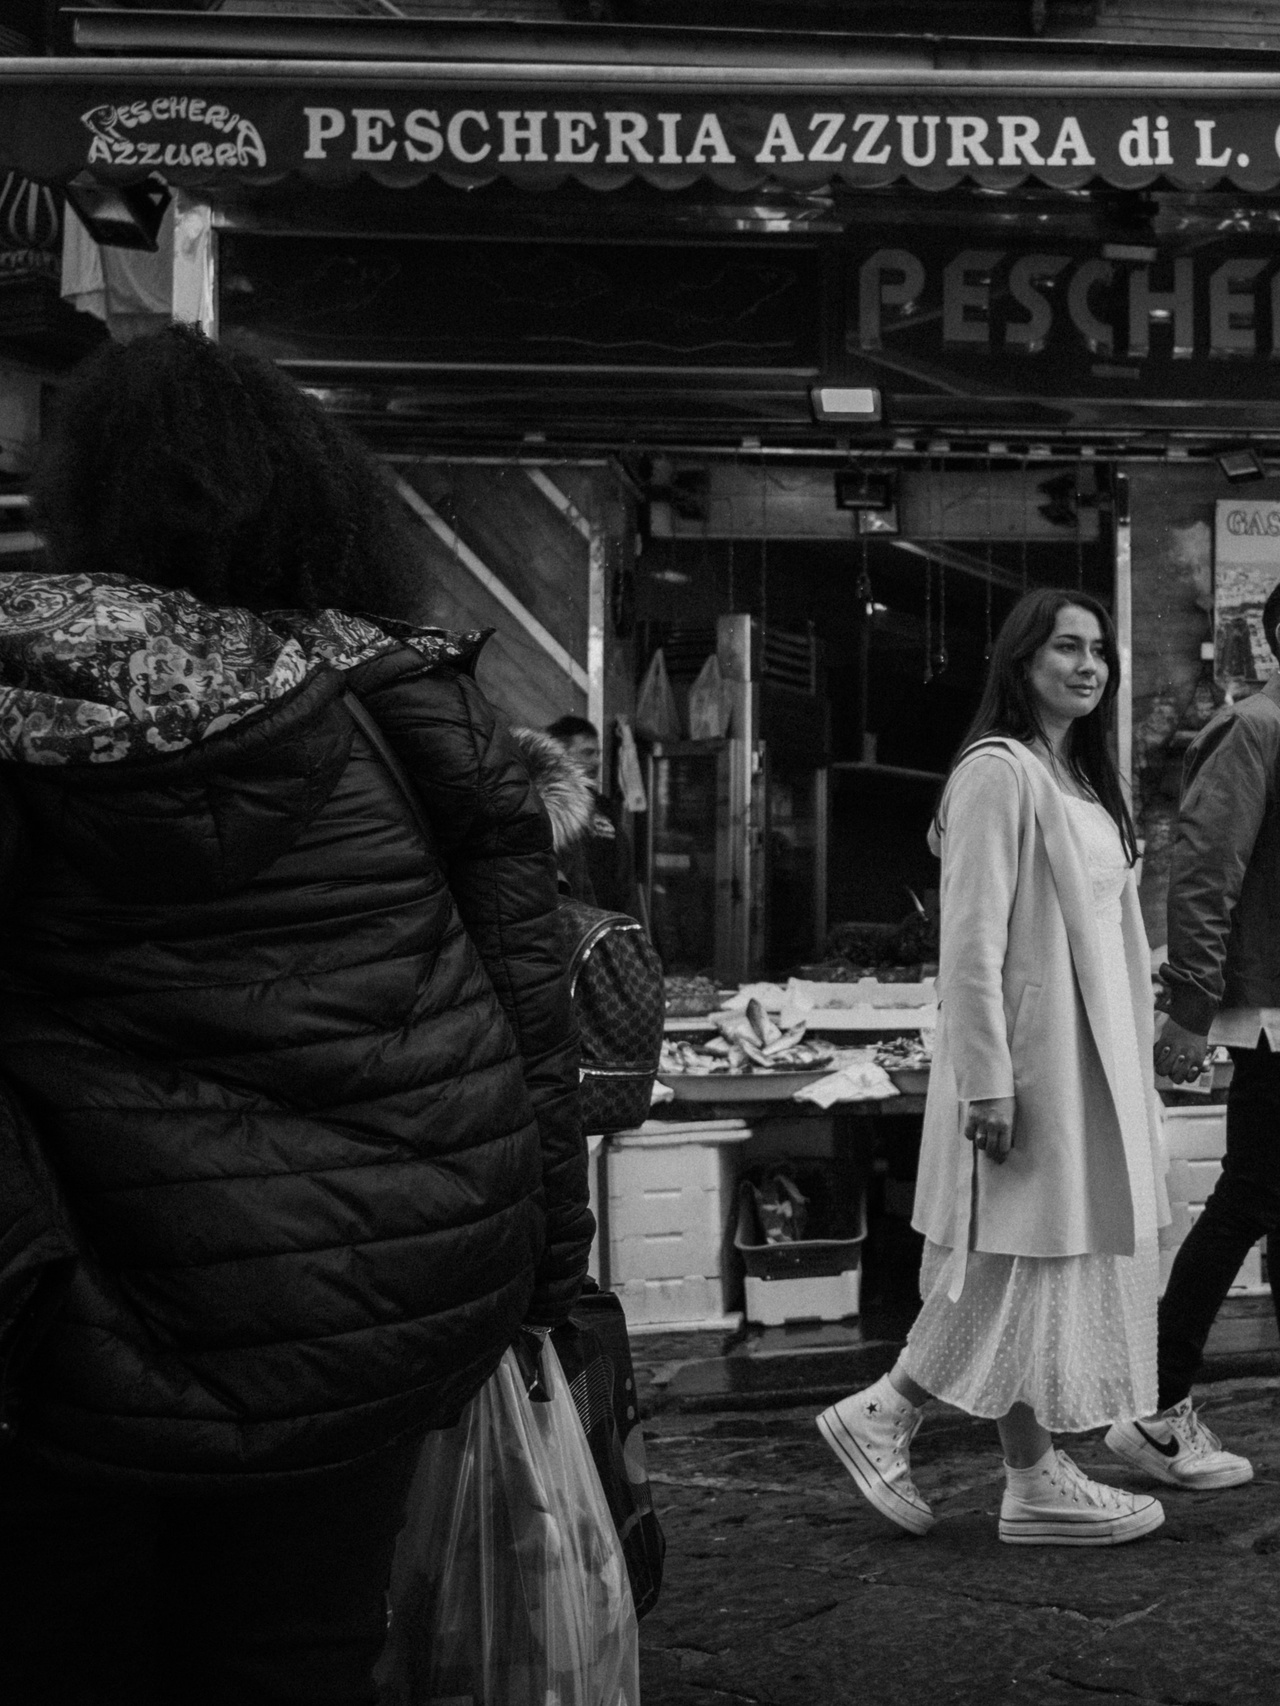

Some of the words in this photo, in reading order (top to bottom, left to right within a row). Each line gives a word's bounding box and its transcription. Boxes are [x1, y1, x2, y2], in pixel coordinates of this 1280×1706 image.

[88, 124, 267, 168] AZZURRA
[303, 106, 737, 165] PESCHERIA
[754, 112, 1096, 168] AZZURRA
[1117, 115, 1176, 168] di
[1194, 117, 1251, 169] L.
